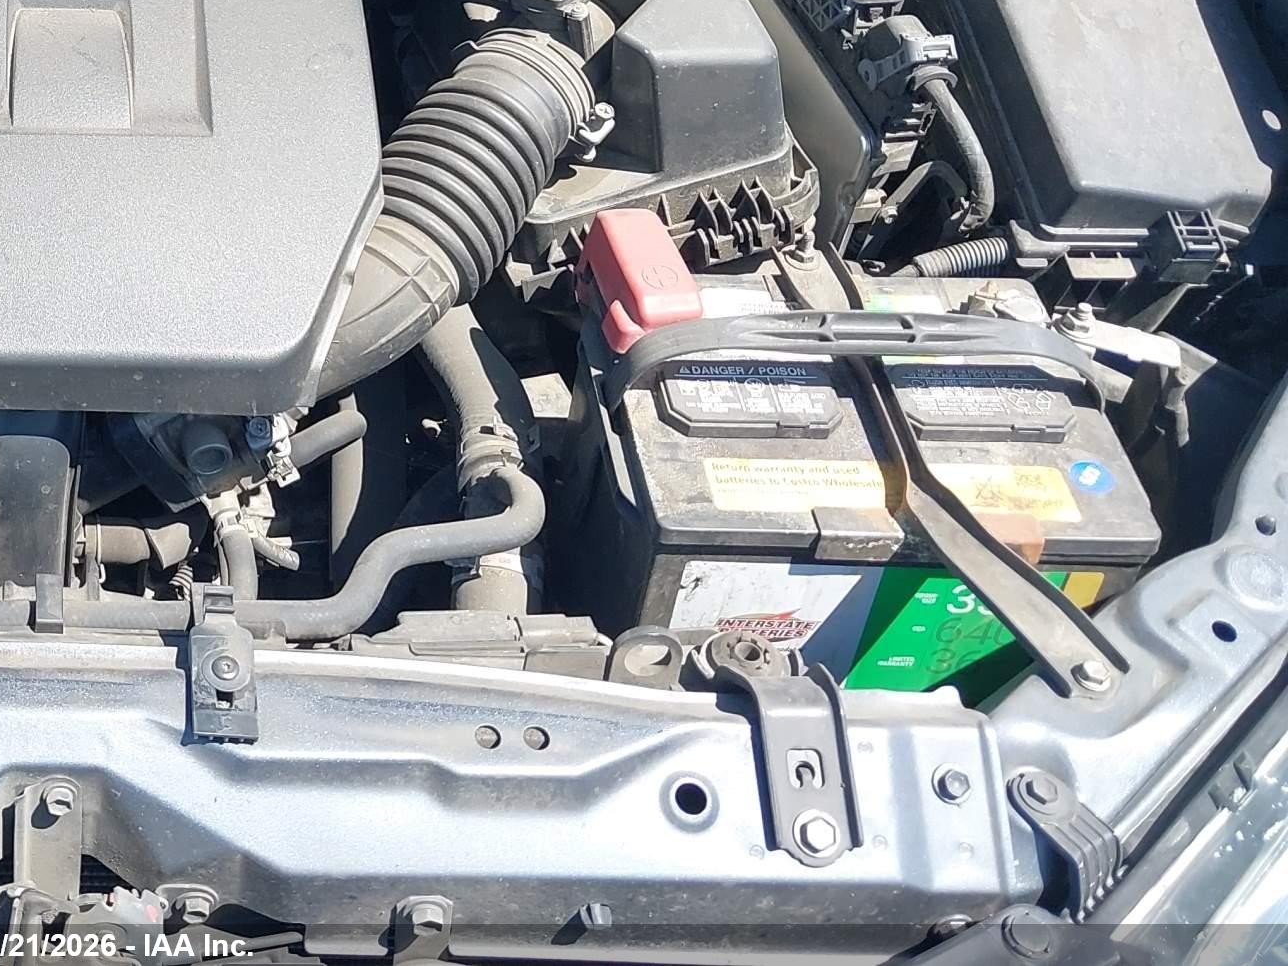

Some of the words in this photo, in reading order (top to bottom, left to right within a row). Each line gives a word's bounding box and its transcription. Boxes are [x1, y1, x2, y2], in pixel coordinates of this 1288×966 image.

[691, 365, 744, 375] DANGER
[758, 366, 807, 376] POISON
[711, 462, 749, 472] Return
[754, 464, 804, 474] warranty
[808, 465, 829, 474] and
[833, 466, 860, 475] used
[714, 475, 765, 485] batteries
[717, 619, 815, 630] INTERSTATE
